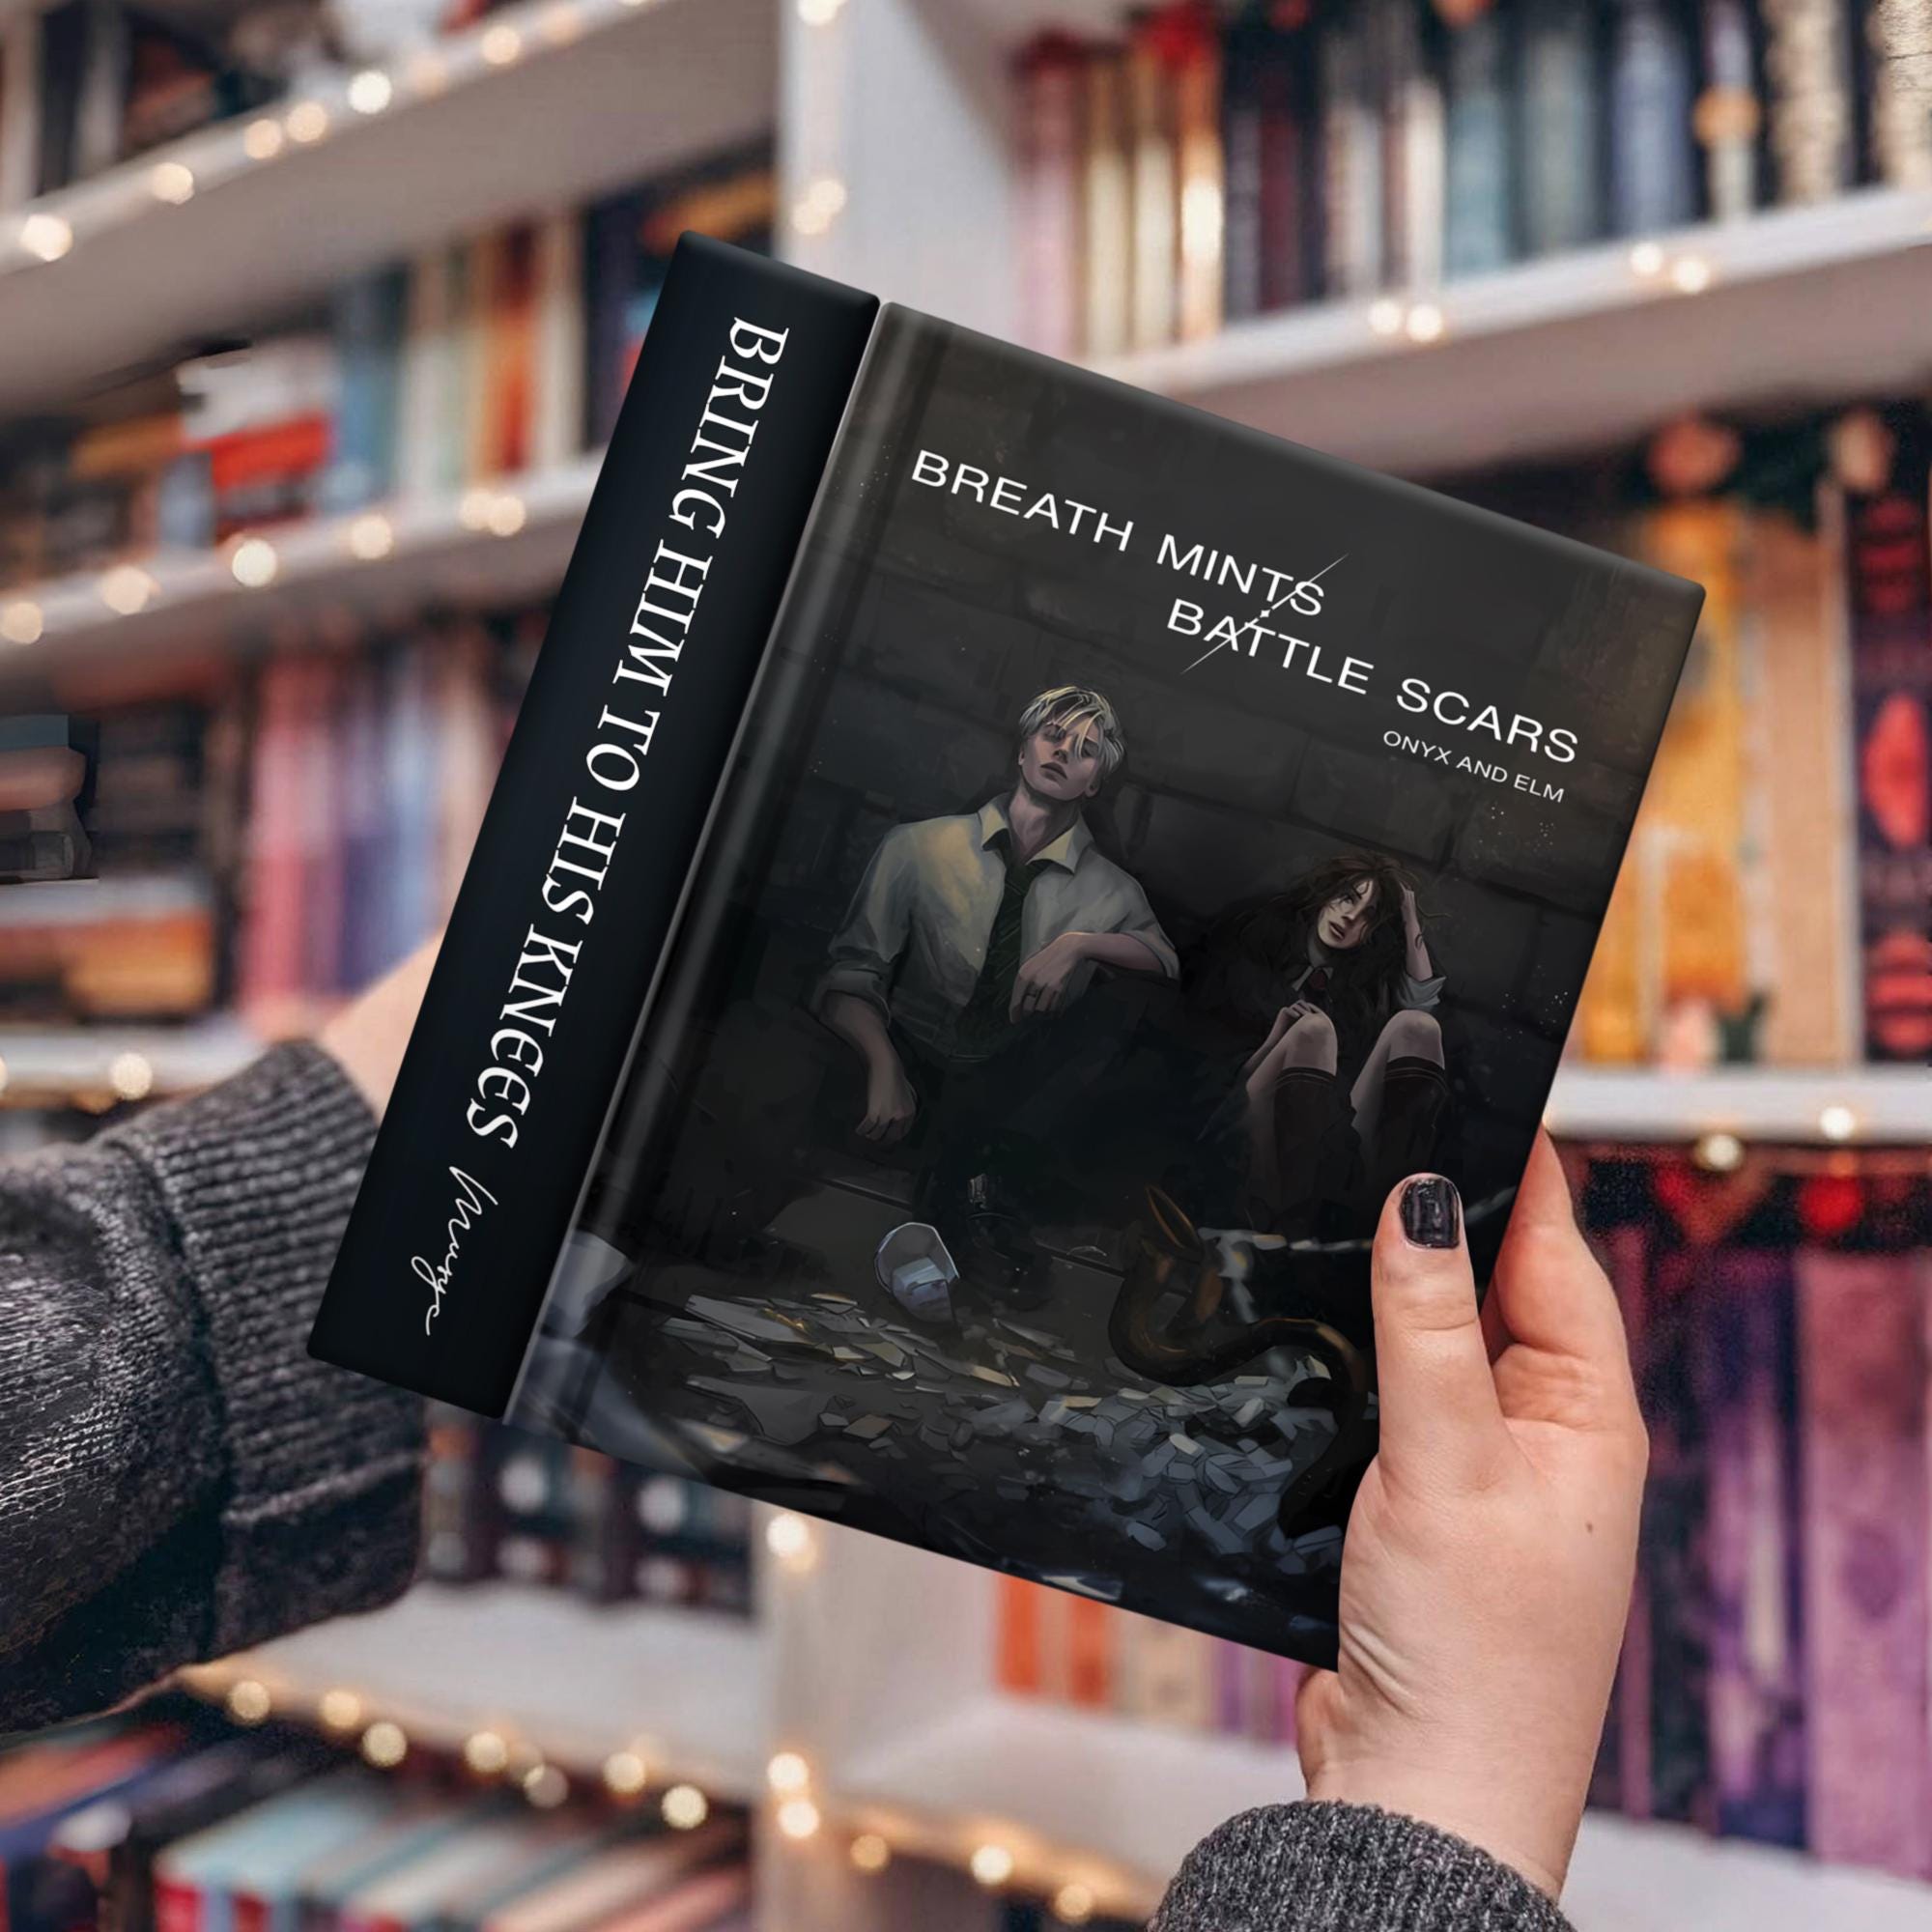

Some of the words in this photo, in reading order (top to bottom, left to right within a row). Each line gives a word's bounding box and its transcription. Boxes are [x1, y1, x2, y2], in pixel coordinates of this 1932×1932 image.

[669, 317, 790, 539] BRING
[912, 450, 1133, 552] BREATH
[1157, 533, 1325, 616] MINTS
[612, 538, 714, 697] HIM
[1167, 598, 1374, 696] BATTLE
[1397, 678, 1578, 763] SCARS
[585, 704, 661, 791] TO
[1383, 730, 1451, 773] ONYX
[1456, 755, 1508, 783] AND
[1514, 774, 1565, 803] ELM
[541, 795, 627, 924] HIS
